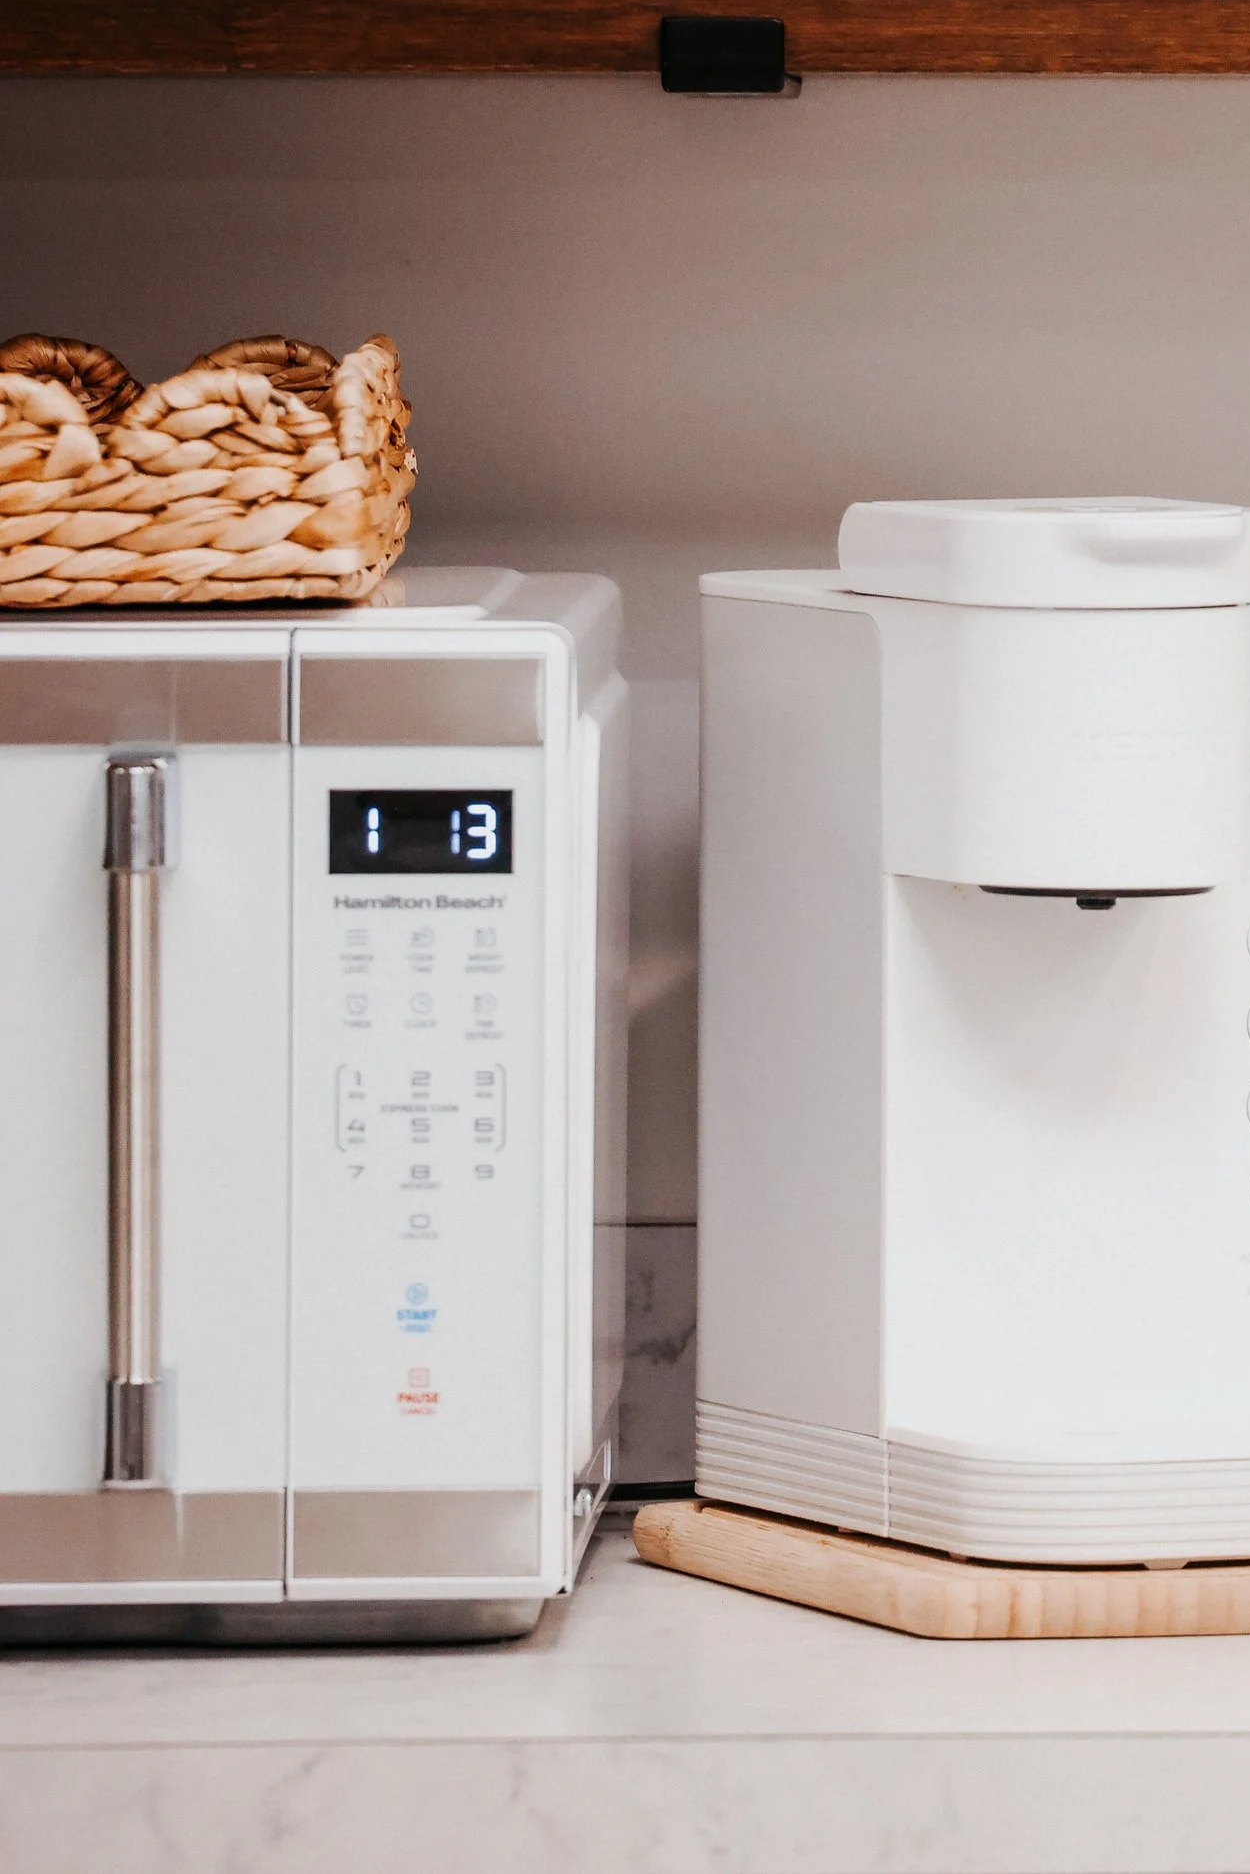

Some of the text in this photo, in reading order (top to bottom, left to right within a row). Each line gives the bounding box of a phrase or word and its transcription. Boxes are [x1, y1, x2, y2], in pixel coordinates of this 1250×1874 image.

[450, 803, 498, 860] 13
[333, 894, 505, 911] Hamilton Beach
[352, 1069, 362, 1086] 1
[410, 1069, 432, 1087] 2
[474, 1069, 496, 1087] 3
[346, 1118, 366, 1134] 4
[410, 1116, 432, 1133] 5
[473, 1116, 495, 1133] 6
[347, 1163, 366, 1180] 7
[410, 1163, 431, 1180] 8
[474, 1163, 496, 1180] 9
[409, 1213, 432, 1229] 0
[397, 1391, 440, 1404] PAUSE
